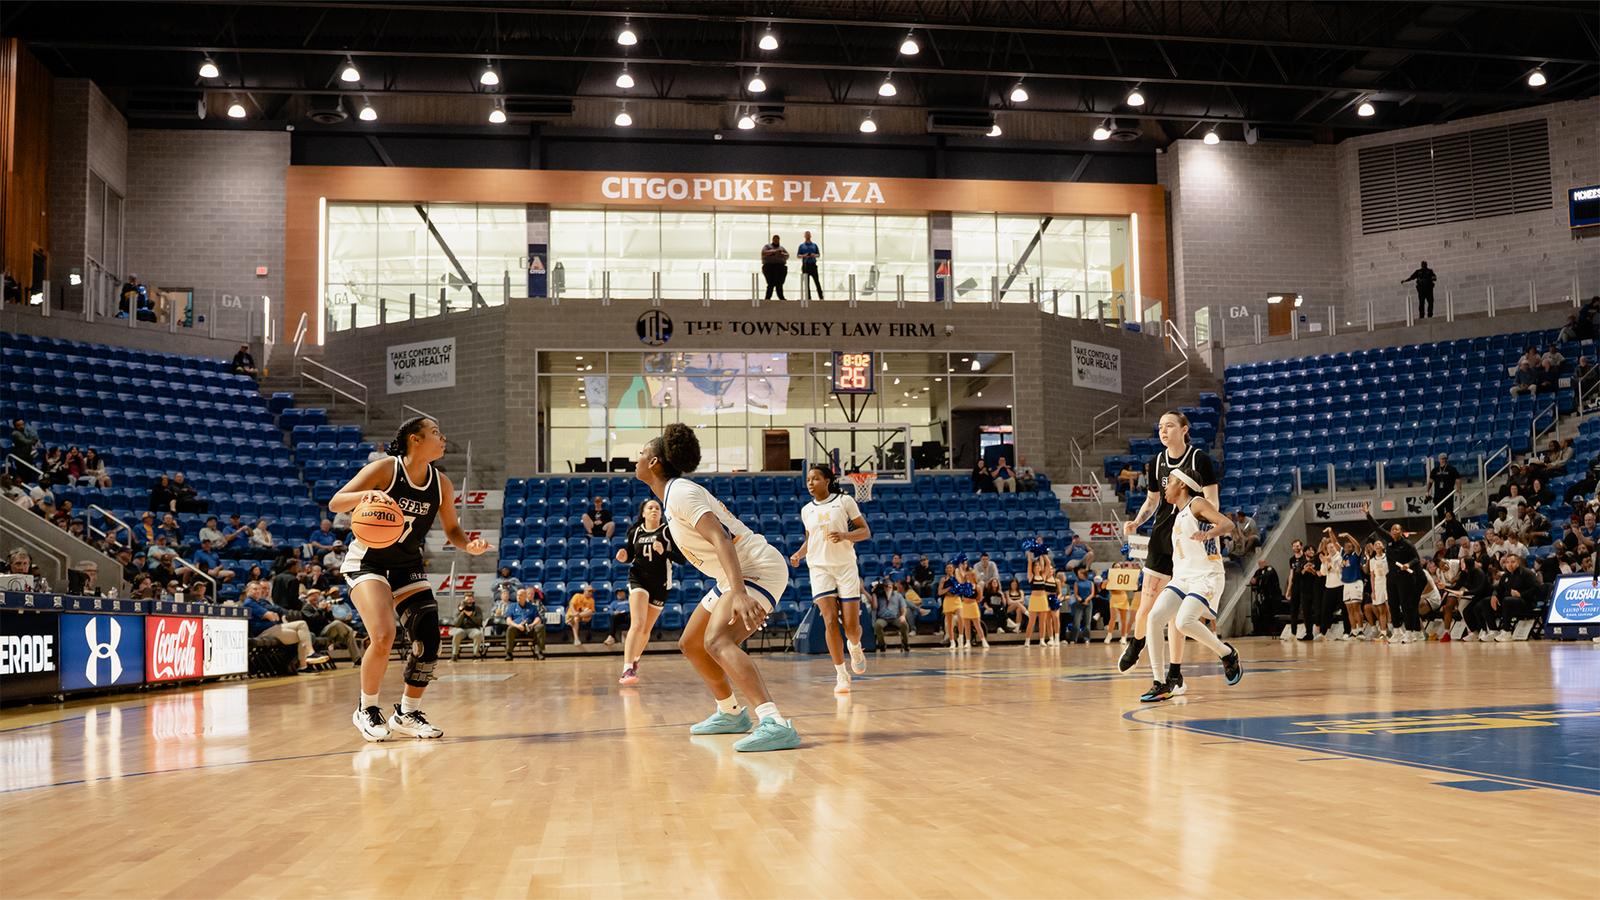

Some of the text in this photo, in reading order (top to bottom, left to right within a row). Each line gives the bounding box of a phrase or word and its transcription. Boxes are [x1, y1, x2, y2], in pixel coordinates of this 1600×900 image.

[601, 177, 885, 203] CITGO POKE PLAZA
[222, 294, 242, 308] GA
[1230, 306, 1249, 318] GA
[683, 321, 935, 338] THE TOWNSLEY LAW FIRM
[391, 345, 452, 360] TAKE CONTROL OF
[1073, 346, 1087, 356] TAKE
[1088, 349, 1111, 361] CONTROL
[393, 354, 450, 370] YOUR HEALTH
[842, 354, 871, 367] 8:02
[1076, 355, 1118, 371] YOUR HEALTH
[840, 366, 866, 388] 26
[361, 510, 396, 523] Wilson
[642, 544, 653, 562] 4
[437, 575, 478, 592] ACE
[1117, 574, 1130, 585] GO
